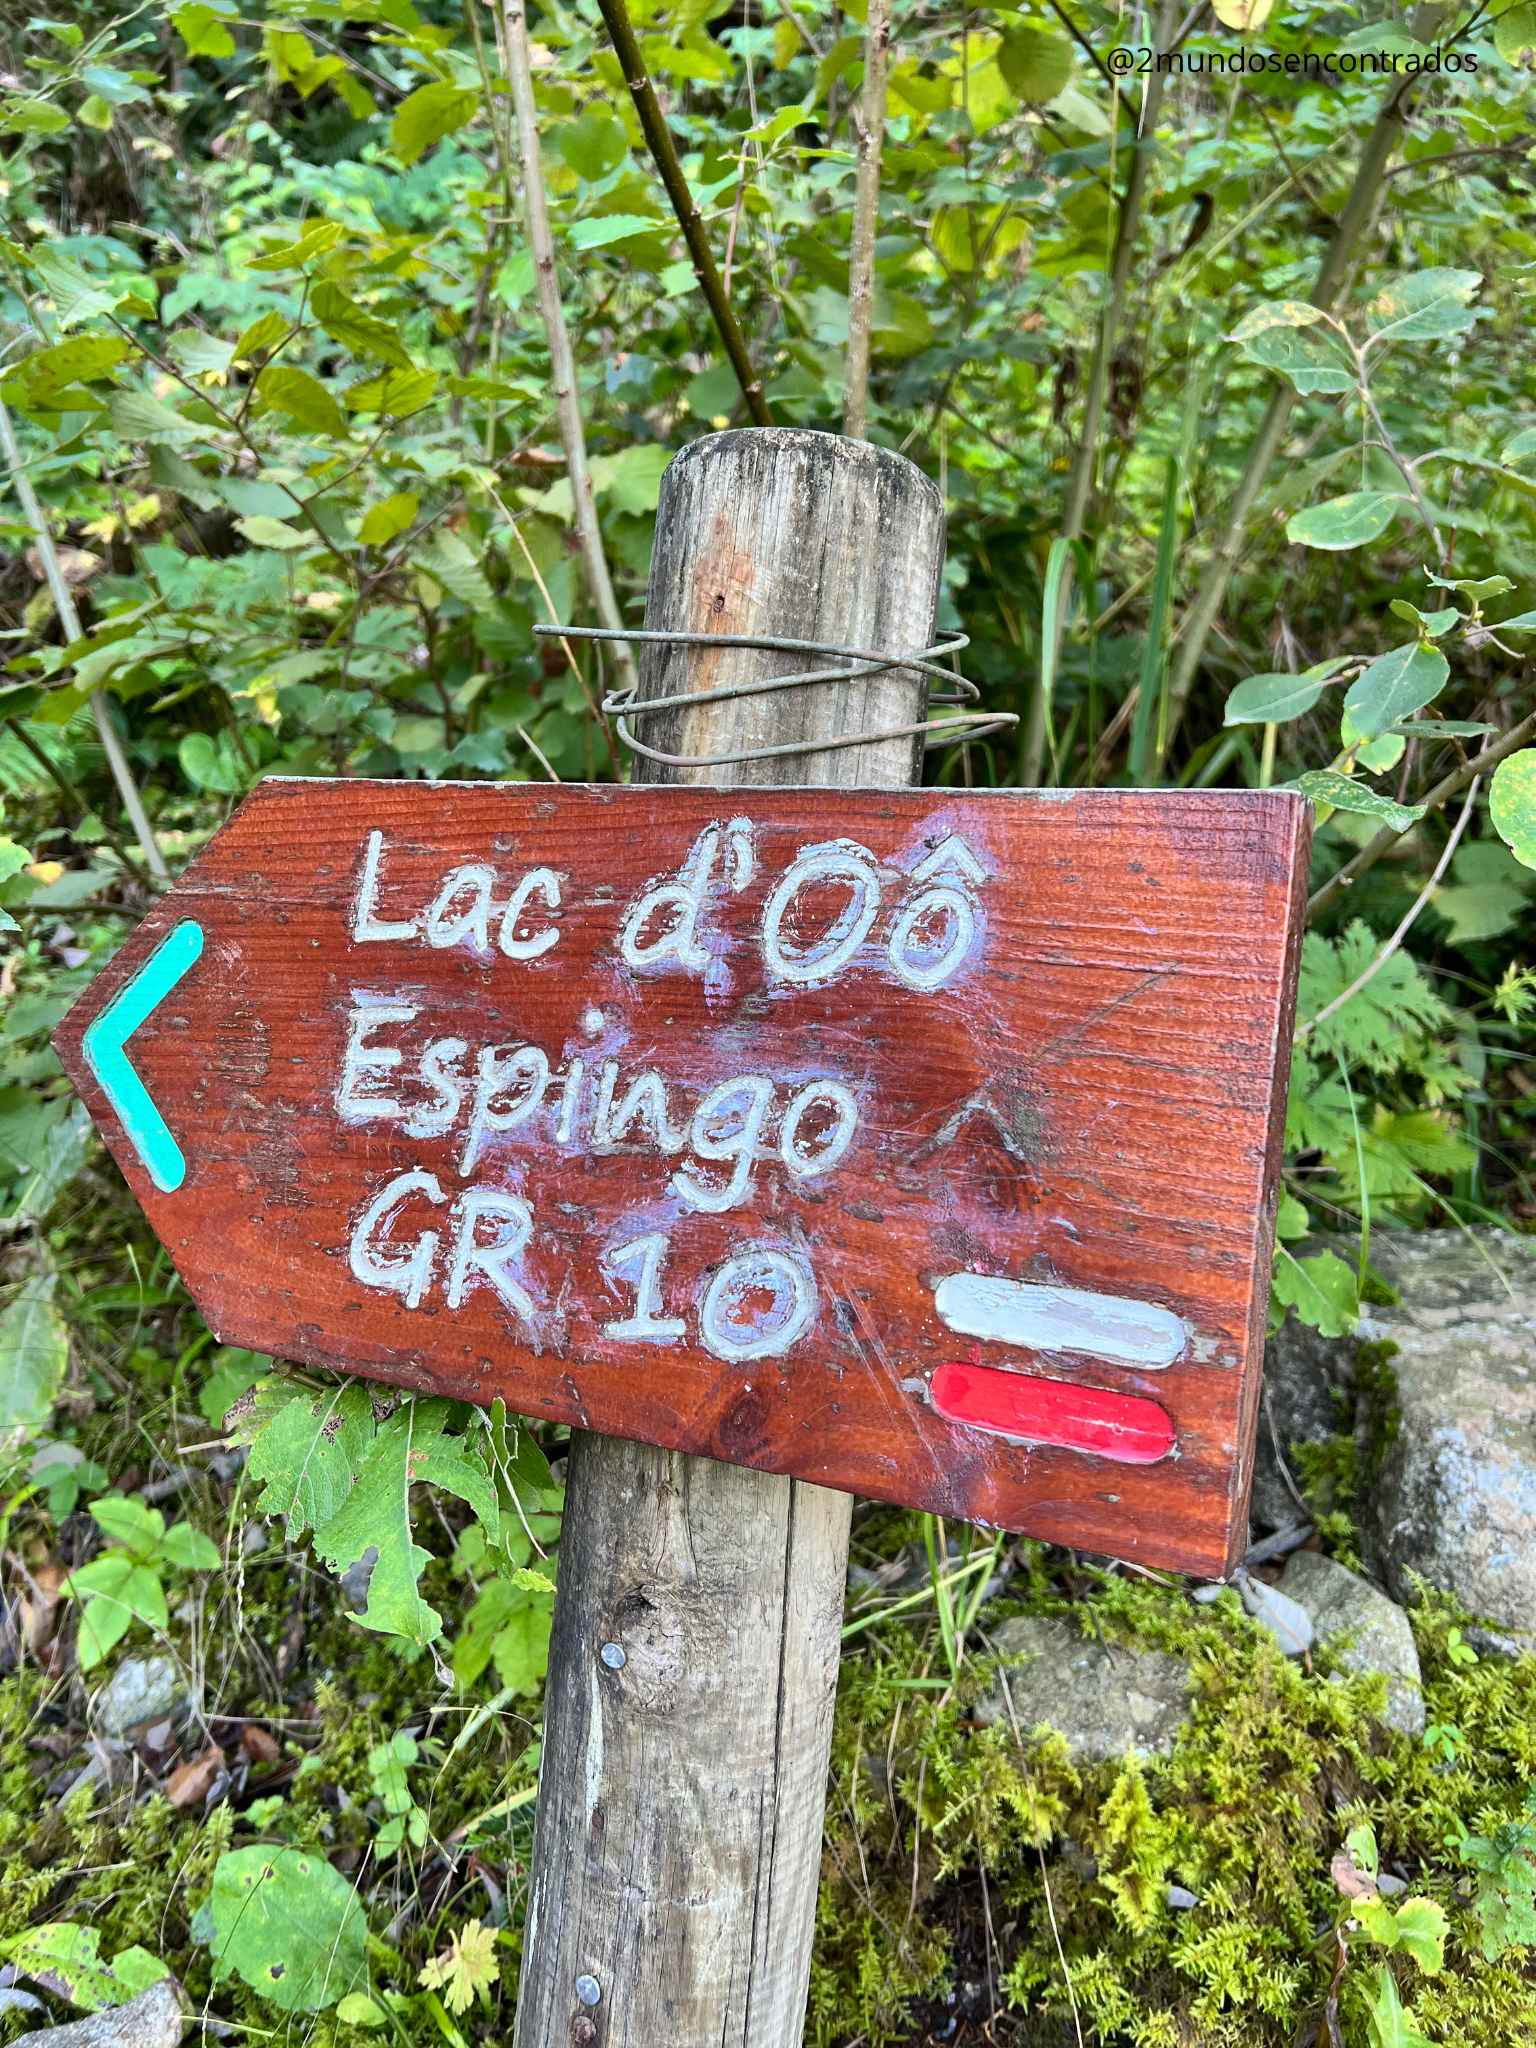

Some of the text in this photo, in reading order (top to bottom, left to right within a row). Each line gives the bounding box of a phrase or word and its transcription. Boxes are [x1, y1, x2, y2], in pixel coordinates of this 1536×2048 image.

[350, 829, 562, 961] Lac
[335, 1003, 859, 1213] Espingo
[348, 1167, 810, 1361] GR 10
